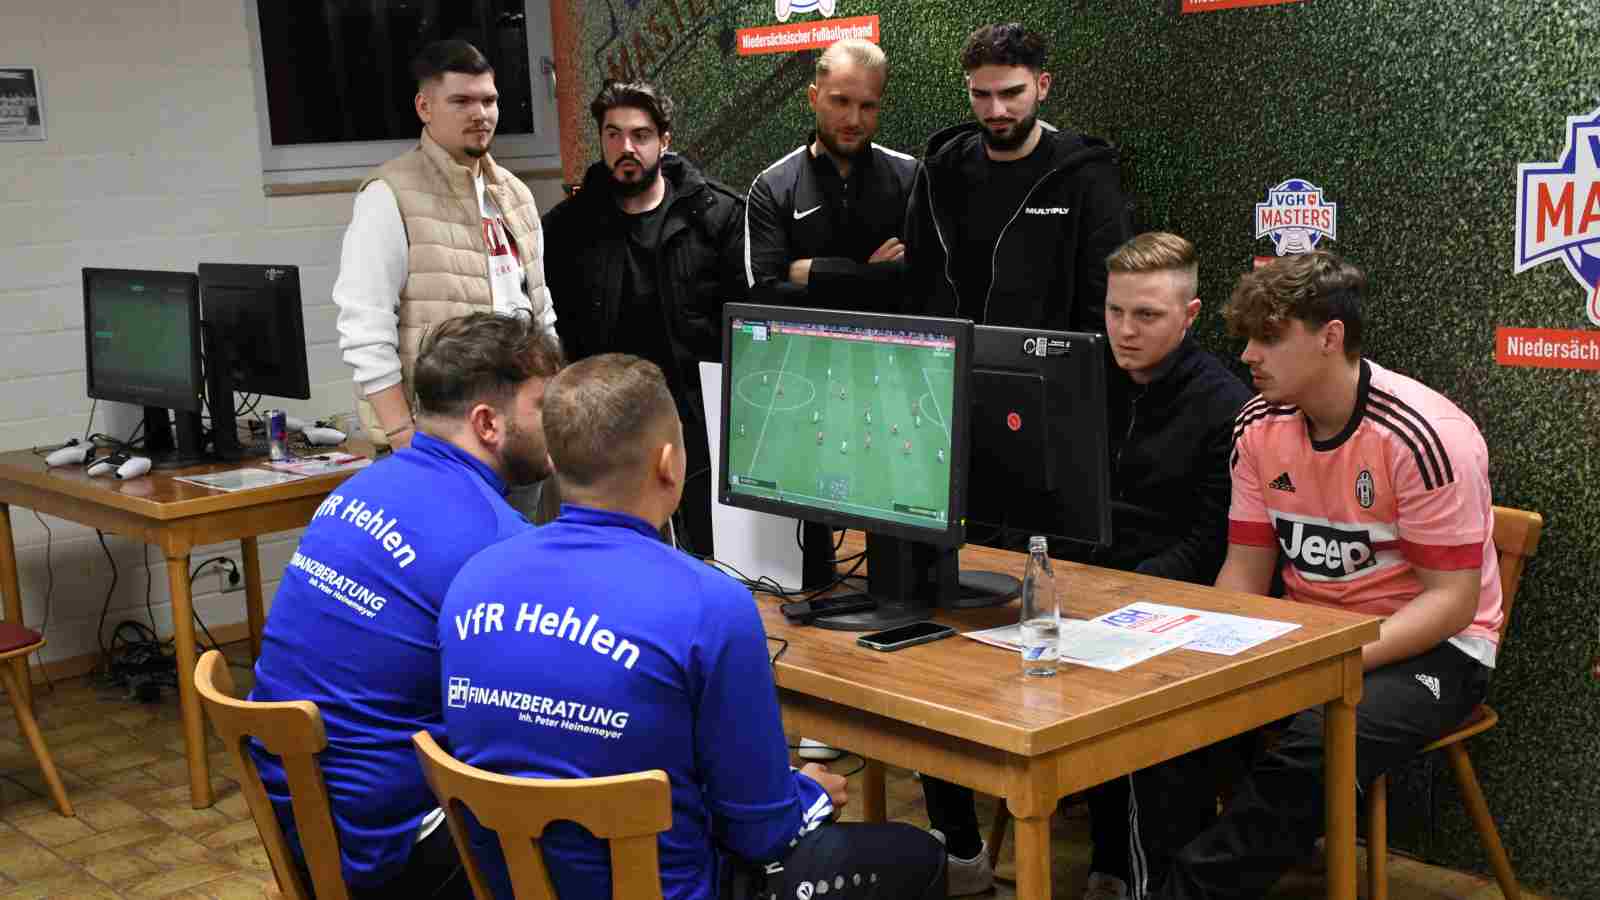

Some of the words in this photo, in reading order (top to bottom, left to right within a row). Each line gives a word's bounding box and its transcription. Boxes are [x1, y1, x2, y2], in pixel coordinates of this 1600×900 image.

[1025, 207, 1070, 215] MULTIPLY
[1275, 193, 1306, 206] VGH
[1261, 207, 1331, 229] MASTERS
[340, 498, 417, 569] Hehlen
[1280, 523, 1371, 575] Jeep
[455, 602, 505, 641] VfR
[515, 602, 640, 670] Hehlen
[468, 686, 630, 729] FINANZBERATUNG
[534, 714, 560, 728] Peter
[560, 719, 624, 739] Heinemeyer
